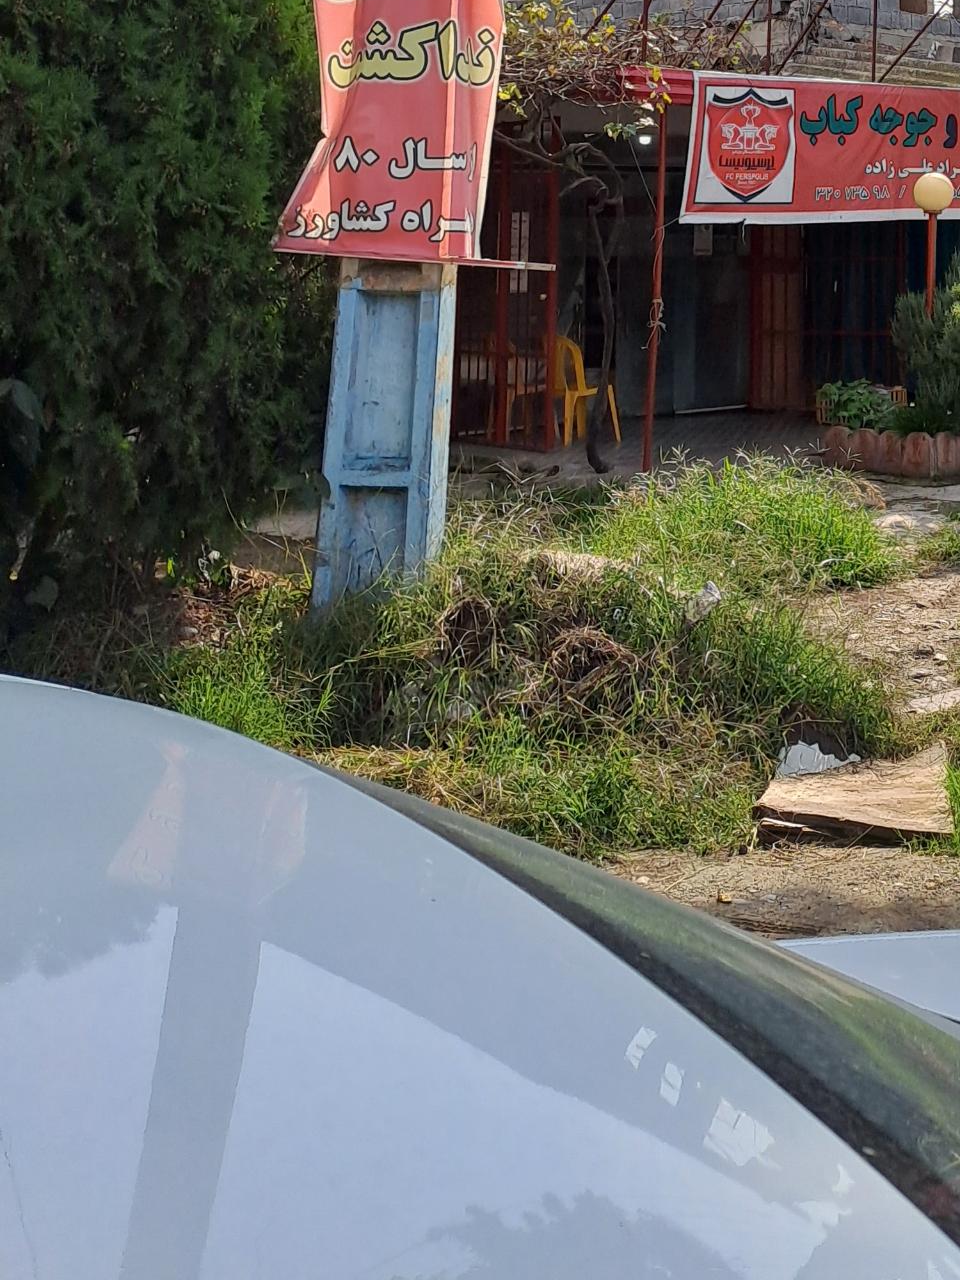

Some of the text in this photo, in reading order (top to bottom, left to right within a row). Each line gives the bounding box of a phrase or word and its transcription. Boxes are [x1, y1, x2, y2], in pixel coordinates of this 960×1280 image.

[800, 94, 864, 147] کباب
[869, 103, 938, 149] جوجه
[943, 113, 958, 149] و
